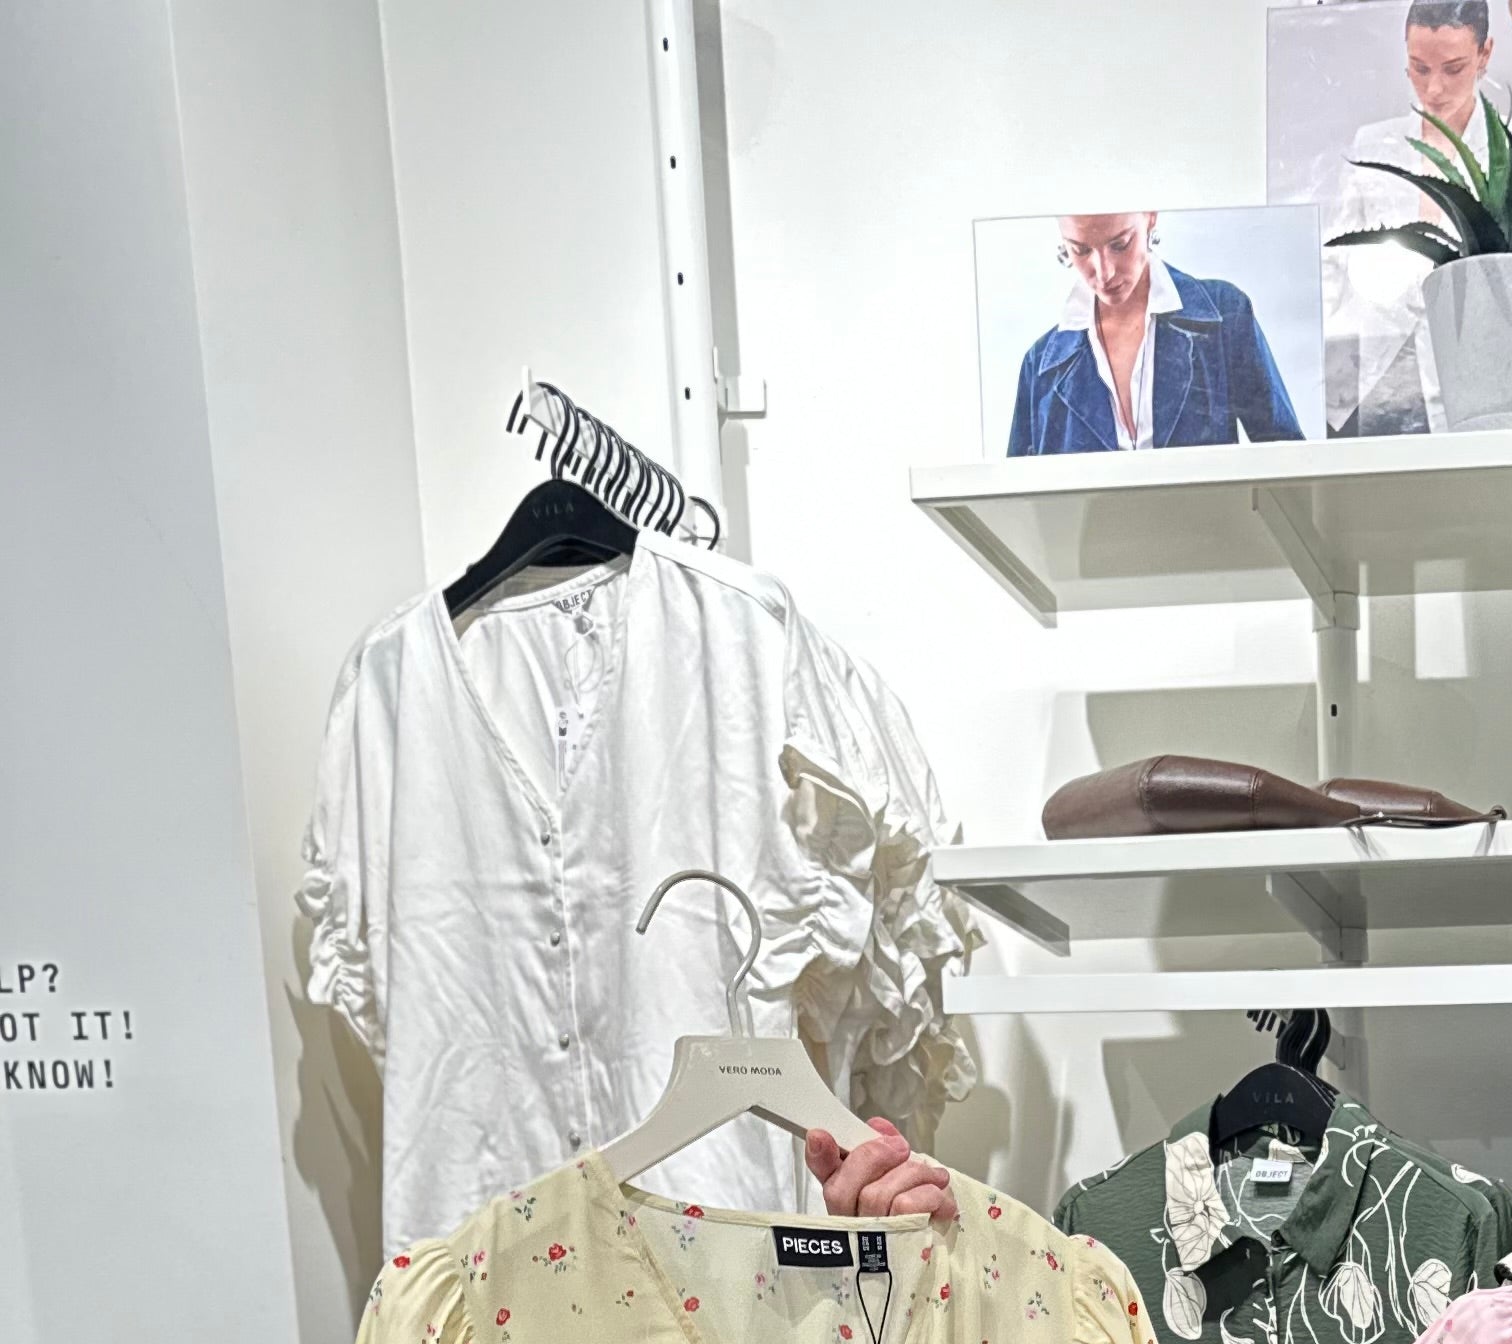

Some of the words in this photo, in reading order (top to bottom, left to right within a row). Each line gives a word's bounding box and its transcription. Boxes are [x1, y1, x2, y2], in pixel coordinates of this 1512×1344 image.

[532, 502, 575, 519] VILA
[70, 1010, 133, 1041] IT!
[3, 1059, 114, 1090] KNOW!
[719, 1065, 748, 1075] VERO
[750, 1066, 782, 1076] MODA
[1251, 1091, 1295, 1104] VILA
[1255, 1169, 1289, 1179] OBJECT
[782, 1236, 844, 1255] PIECES
